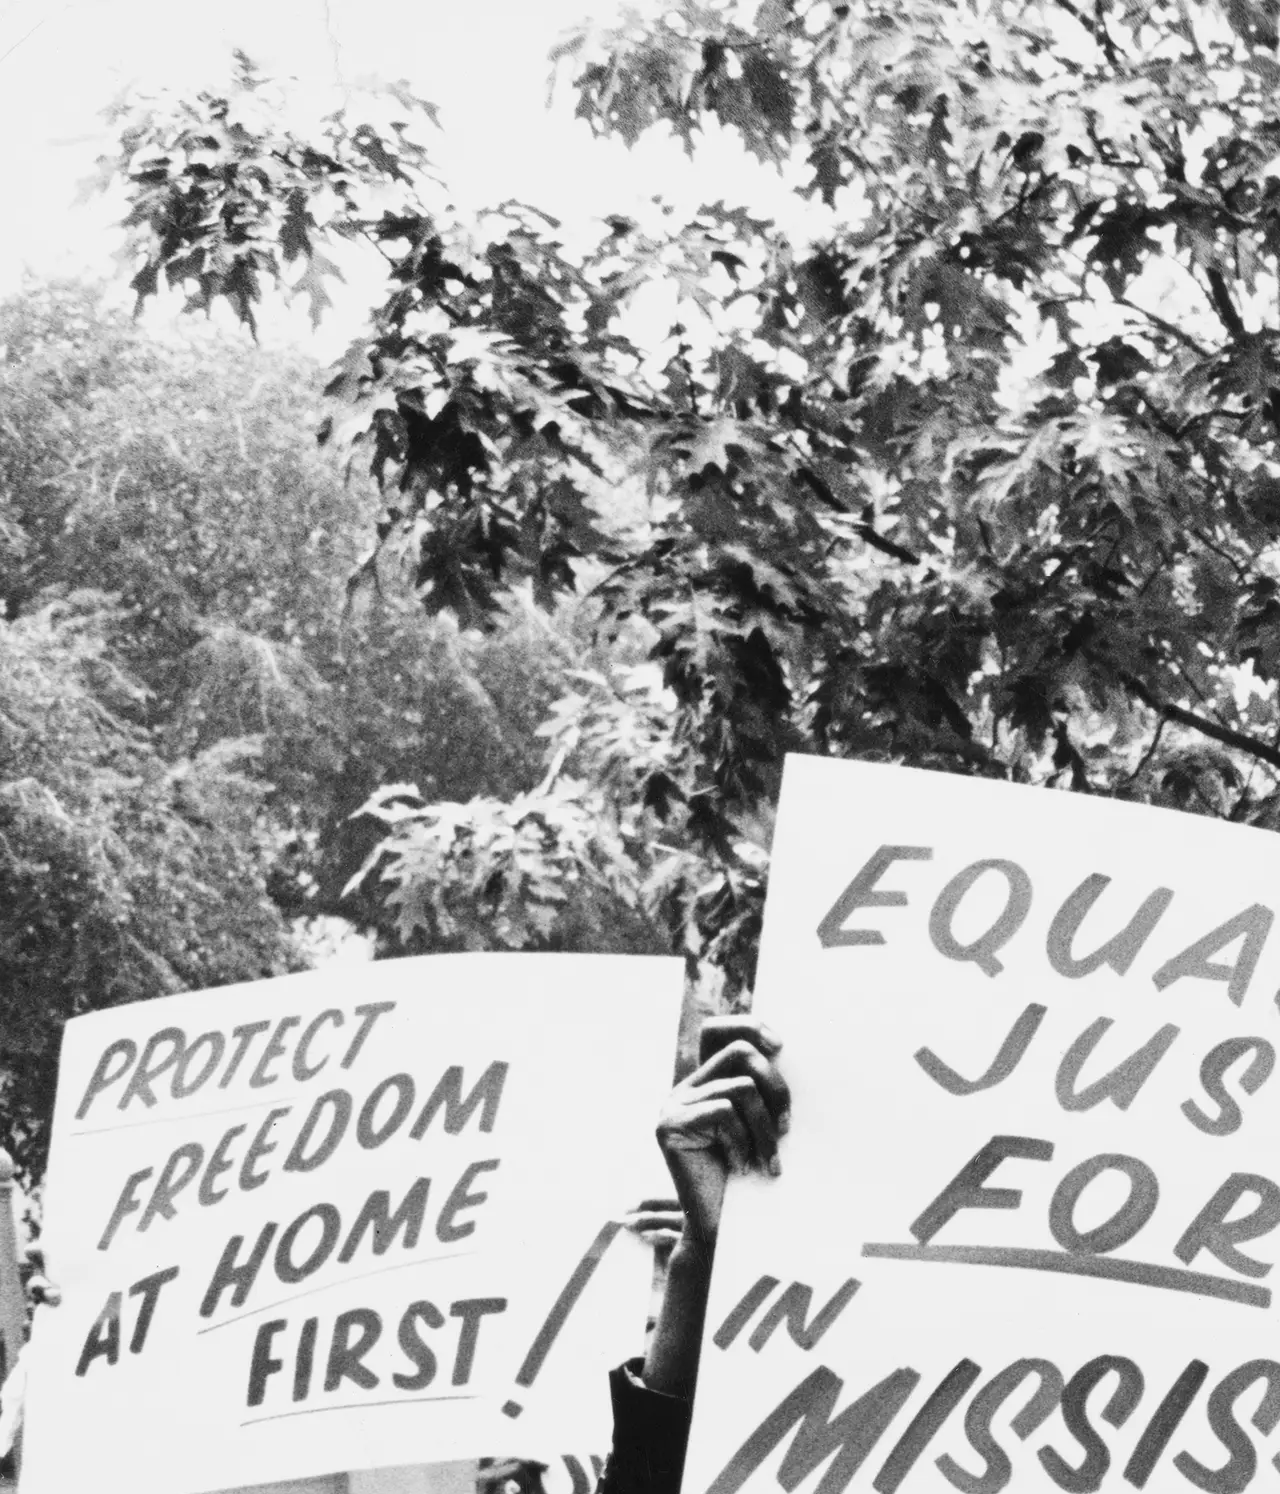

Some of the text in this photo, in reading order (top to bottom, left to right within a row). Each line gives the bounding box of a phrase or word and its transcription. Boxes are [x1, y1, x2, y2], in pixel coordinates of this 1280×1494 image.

[74, 1000, 397, 1120] PROTECT
[96, 1059, 509, 1251] FREEDOM
[75, 1158, 501, 1377] AT HOME
[712, 1273, 863, 1354] IN
